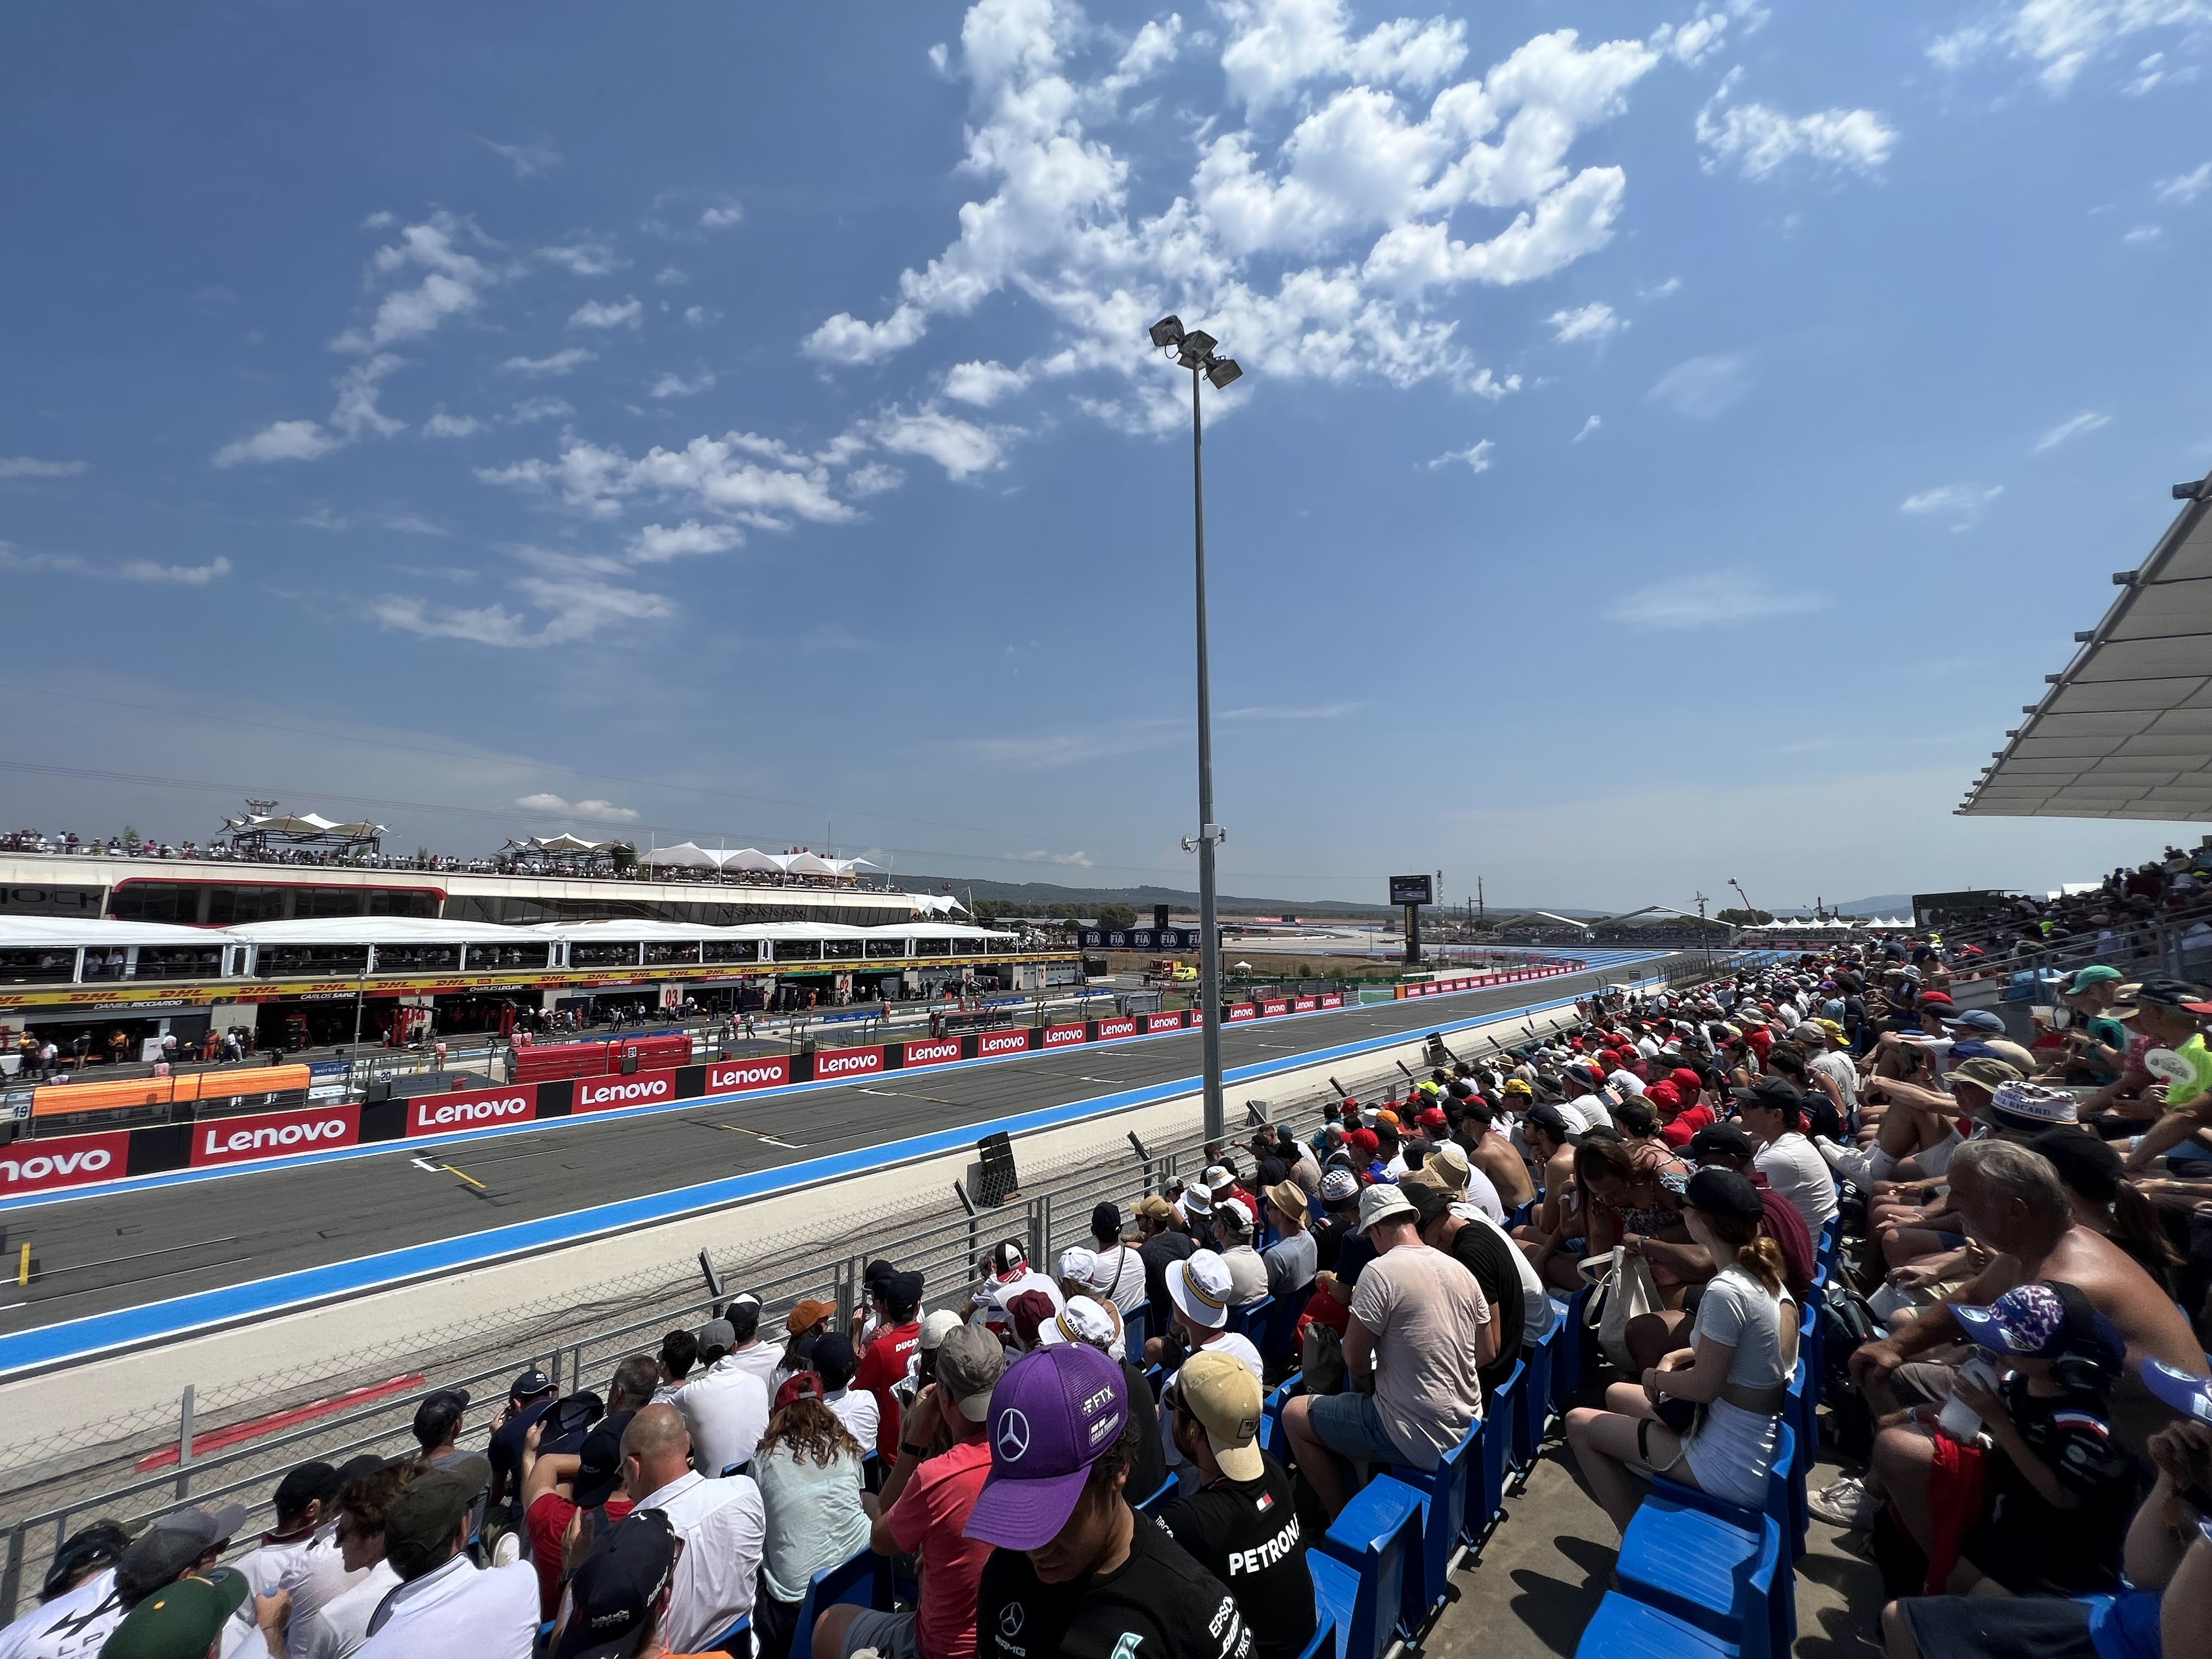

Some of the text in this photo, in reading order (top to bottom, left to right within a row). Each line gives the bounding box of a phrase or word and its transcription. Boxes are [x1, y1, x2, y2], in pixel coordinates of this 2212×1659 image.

[70, 992, 120, 1002] DHL
[158, 989, 204, 998] DHL
[239, 986, 280, 994] DHL
[665, 989, 678, 1005] 03
[1295, 1001, 1313, 1009] Lenovo
[1323, 997, 1340, 1006] Lenovo
[1230, 1008, 1253, 1018] Lenovo
[1265, 1005, 1285, 1014] Lenovo
[1101, 1023, 1133, 1036] Lenovo
[1150, 1017, 1178, 1029] Lenovo
[1046, 1029, 1082, 1043] Lenovo
[983, 1036, 1024, 1051] Lenovo
[629, 1048, 636, 1057] 21
[908, 1045, 957, 1061] Lenovo
[314, 1066, 345, 1074] workday
[819, 1054, 877, 1073] Lenovo
[381, 1071, 391, 1082] 20
[712, 1066, 782, 1087] Lenovo
[582, 1080, 667, 1104] Lenovo
[13, 1106, 27, 1118] 19
[418, 1098, 526, 1126] Lenovo
[205, 1120, 346, 1155] Lenovo
[0, 1149, 110, 1182] novo
[1193, 1279, 1214, 1298] RICARD
[1067, 1318, 1081, 1337] PAUL
[1081, 1334, 1105, 1347] RICARD
[1092, 1385, 1114, 1408] FTX
[1091, 1427, 1103, 1442] GRAN
[1229, 1512, 1300, 1576] PETRON
